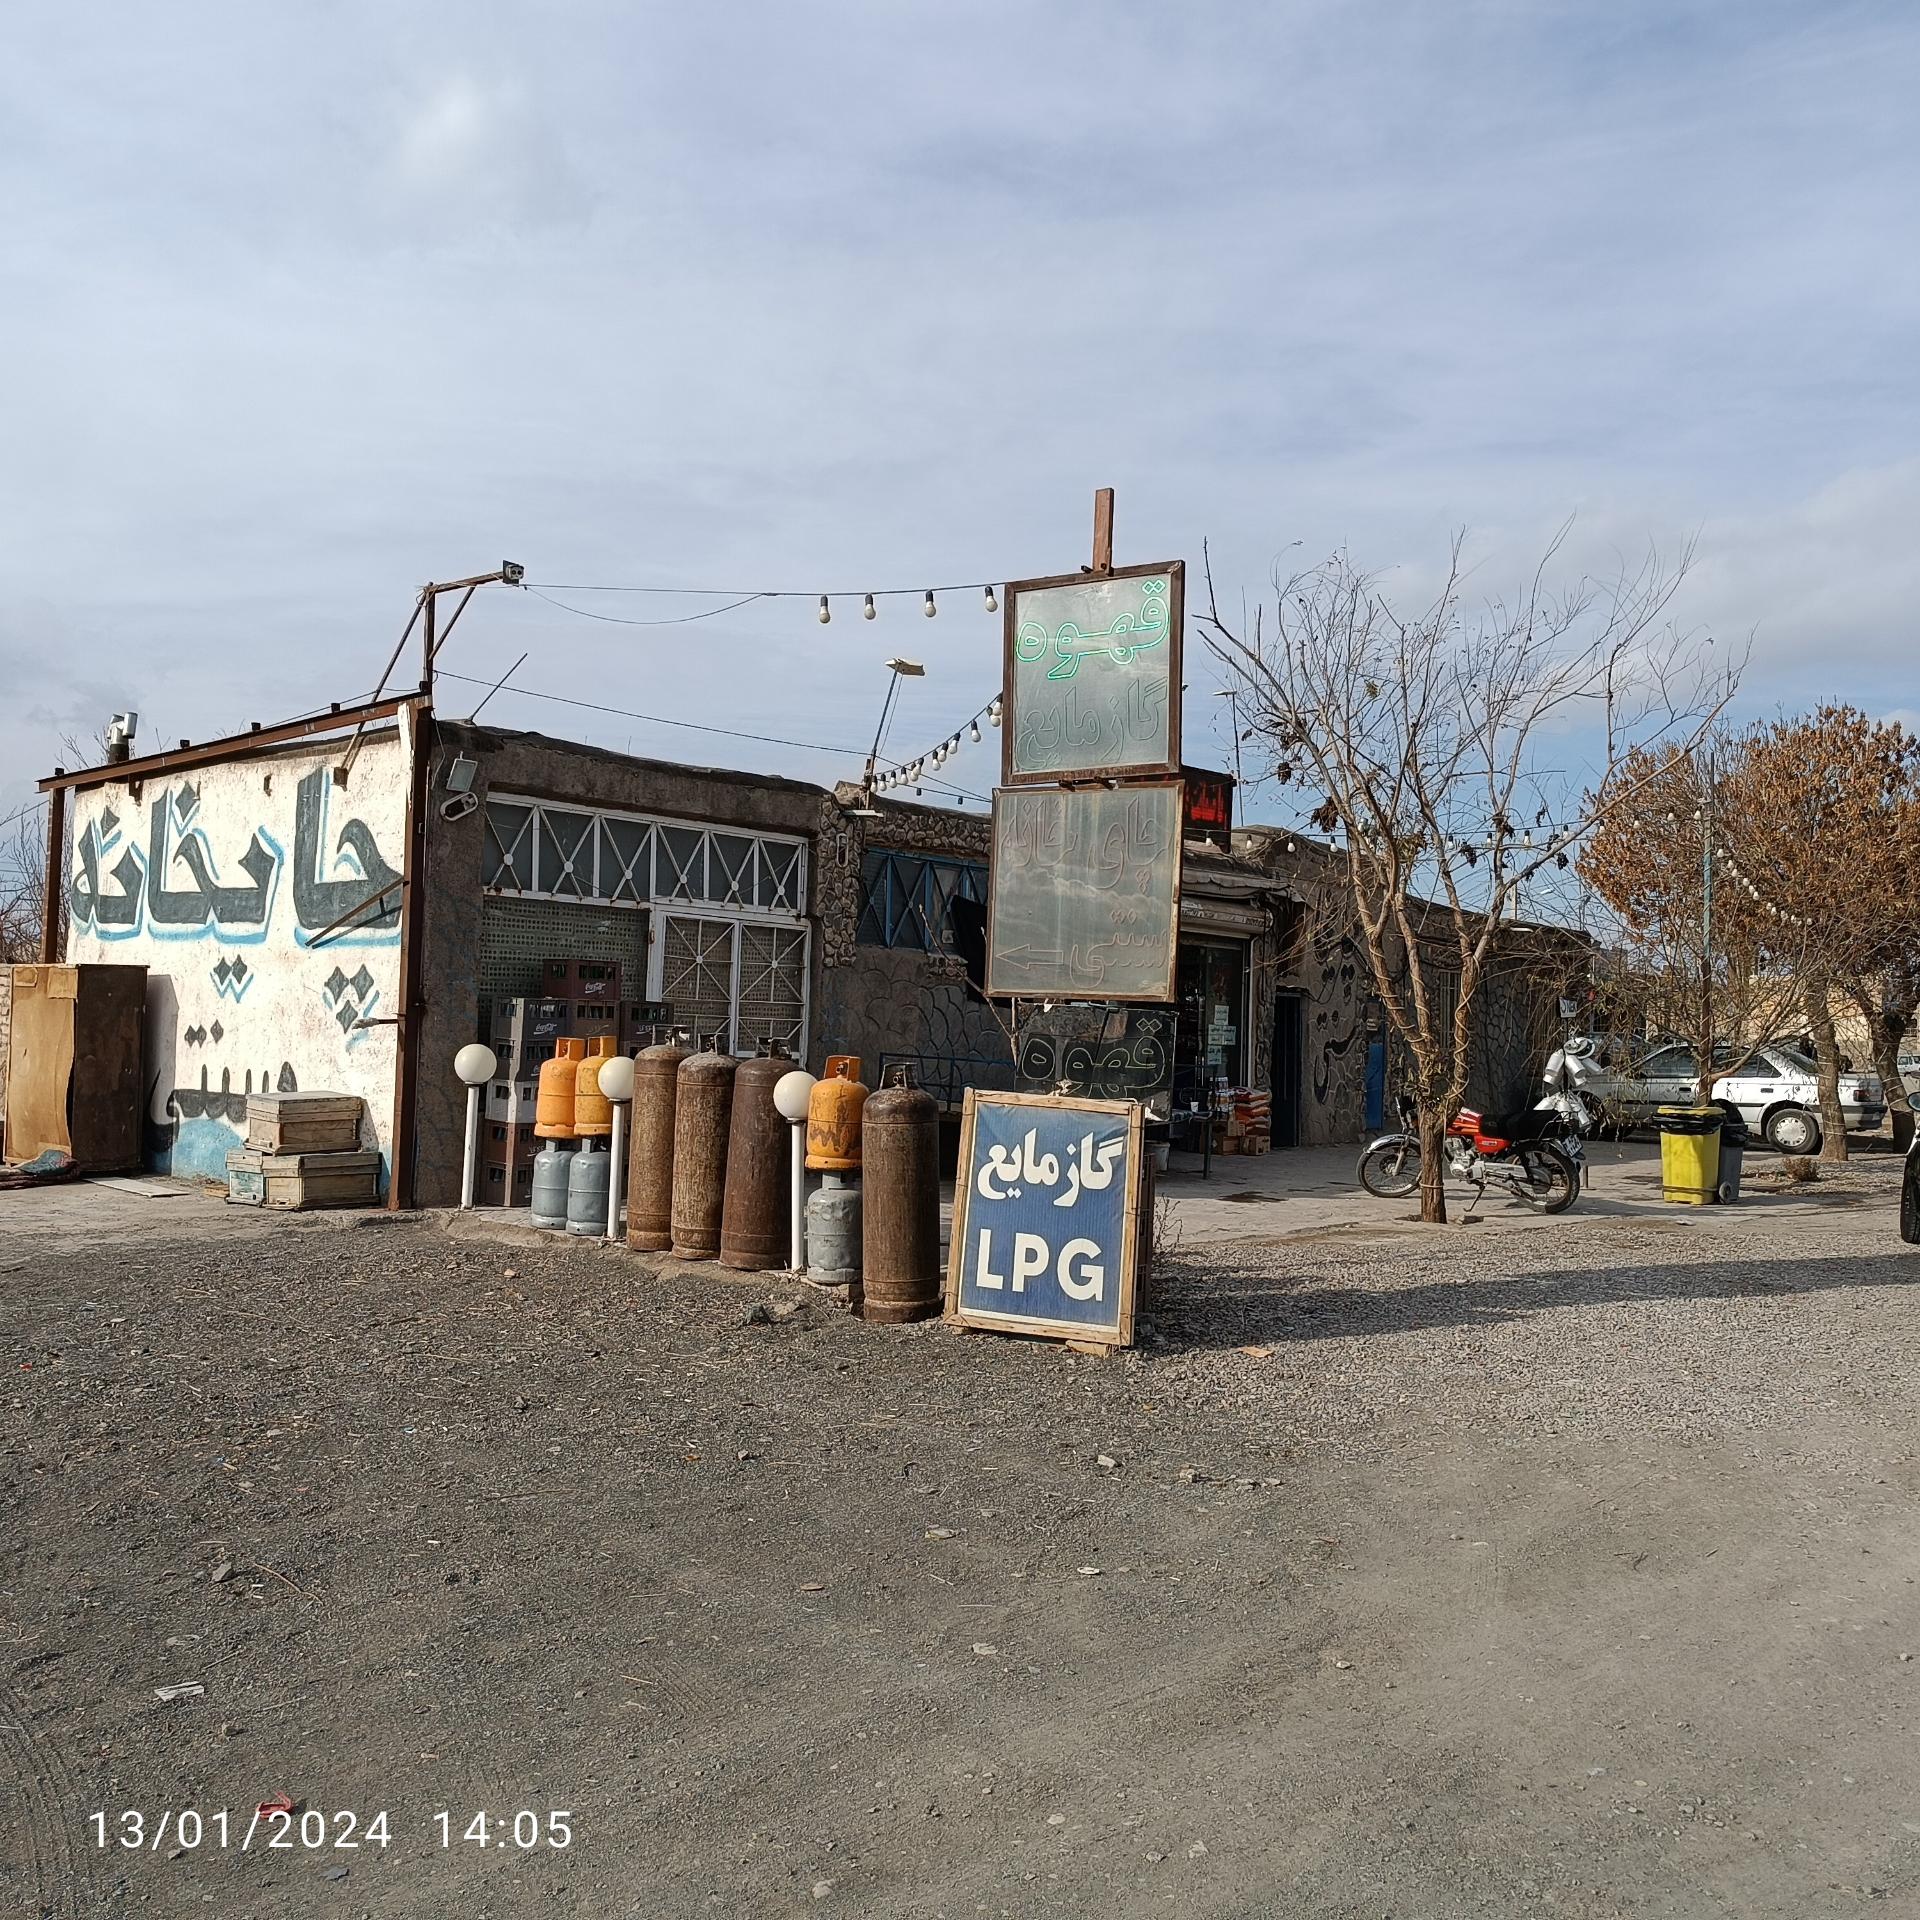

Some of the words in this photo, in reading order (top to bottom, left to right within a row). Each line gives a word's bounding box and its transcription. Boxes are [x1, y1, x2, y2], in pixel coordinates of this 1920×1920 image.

[1015, 579, 1169, 679] قهوه
[1016, 685, 1102, 770] مایع
[1100, 676, 1168, 762] گاز
[1069, 907, 1169, 989] سنتی
[1021, 1017, 1166, 1099] قهوه
[977, 1127, 1060, 1200] مایع
[1053, 1131, 1125, 1207] گاز
[976, 1228, 1105, 1302] LPG
